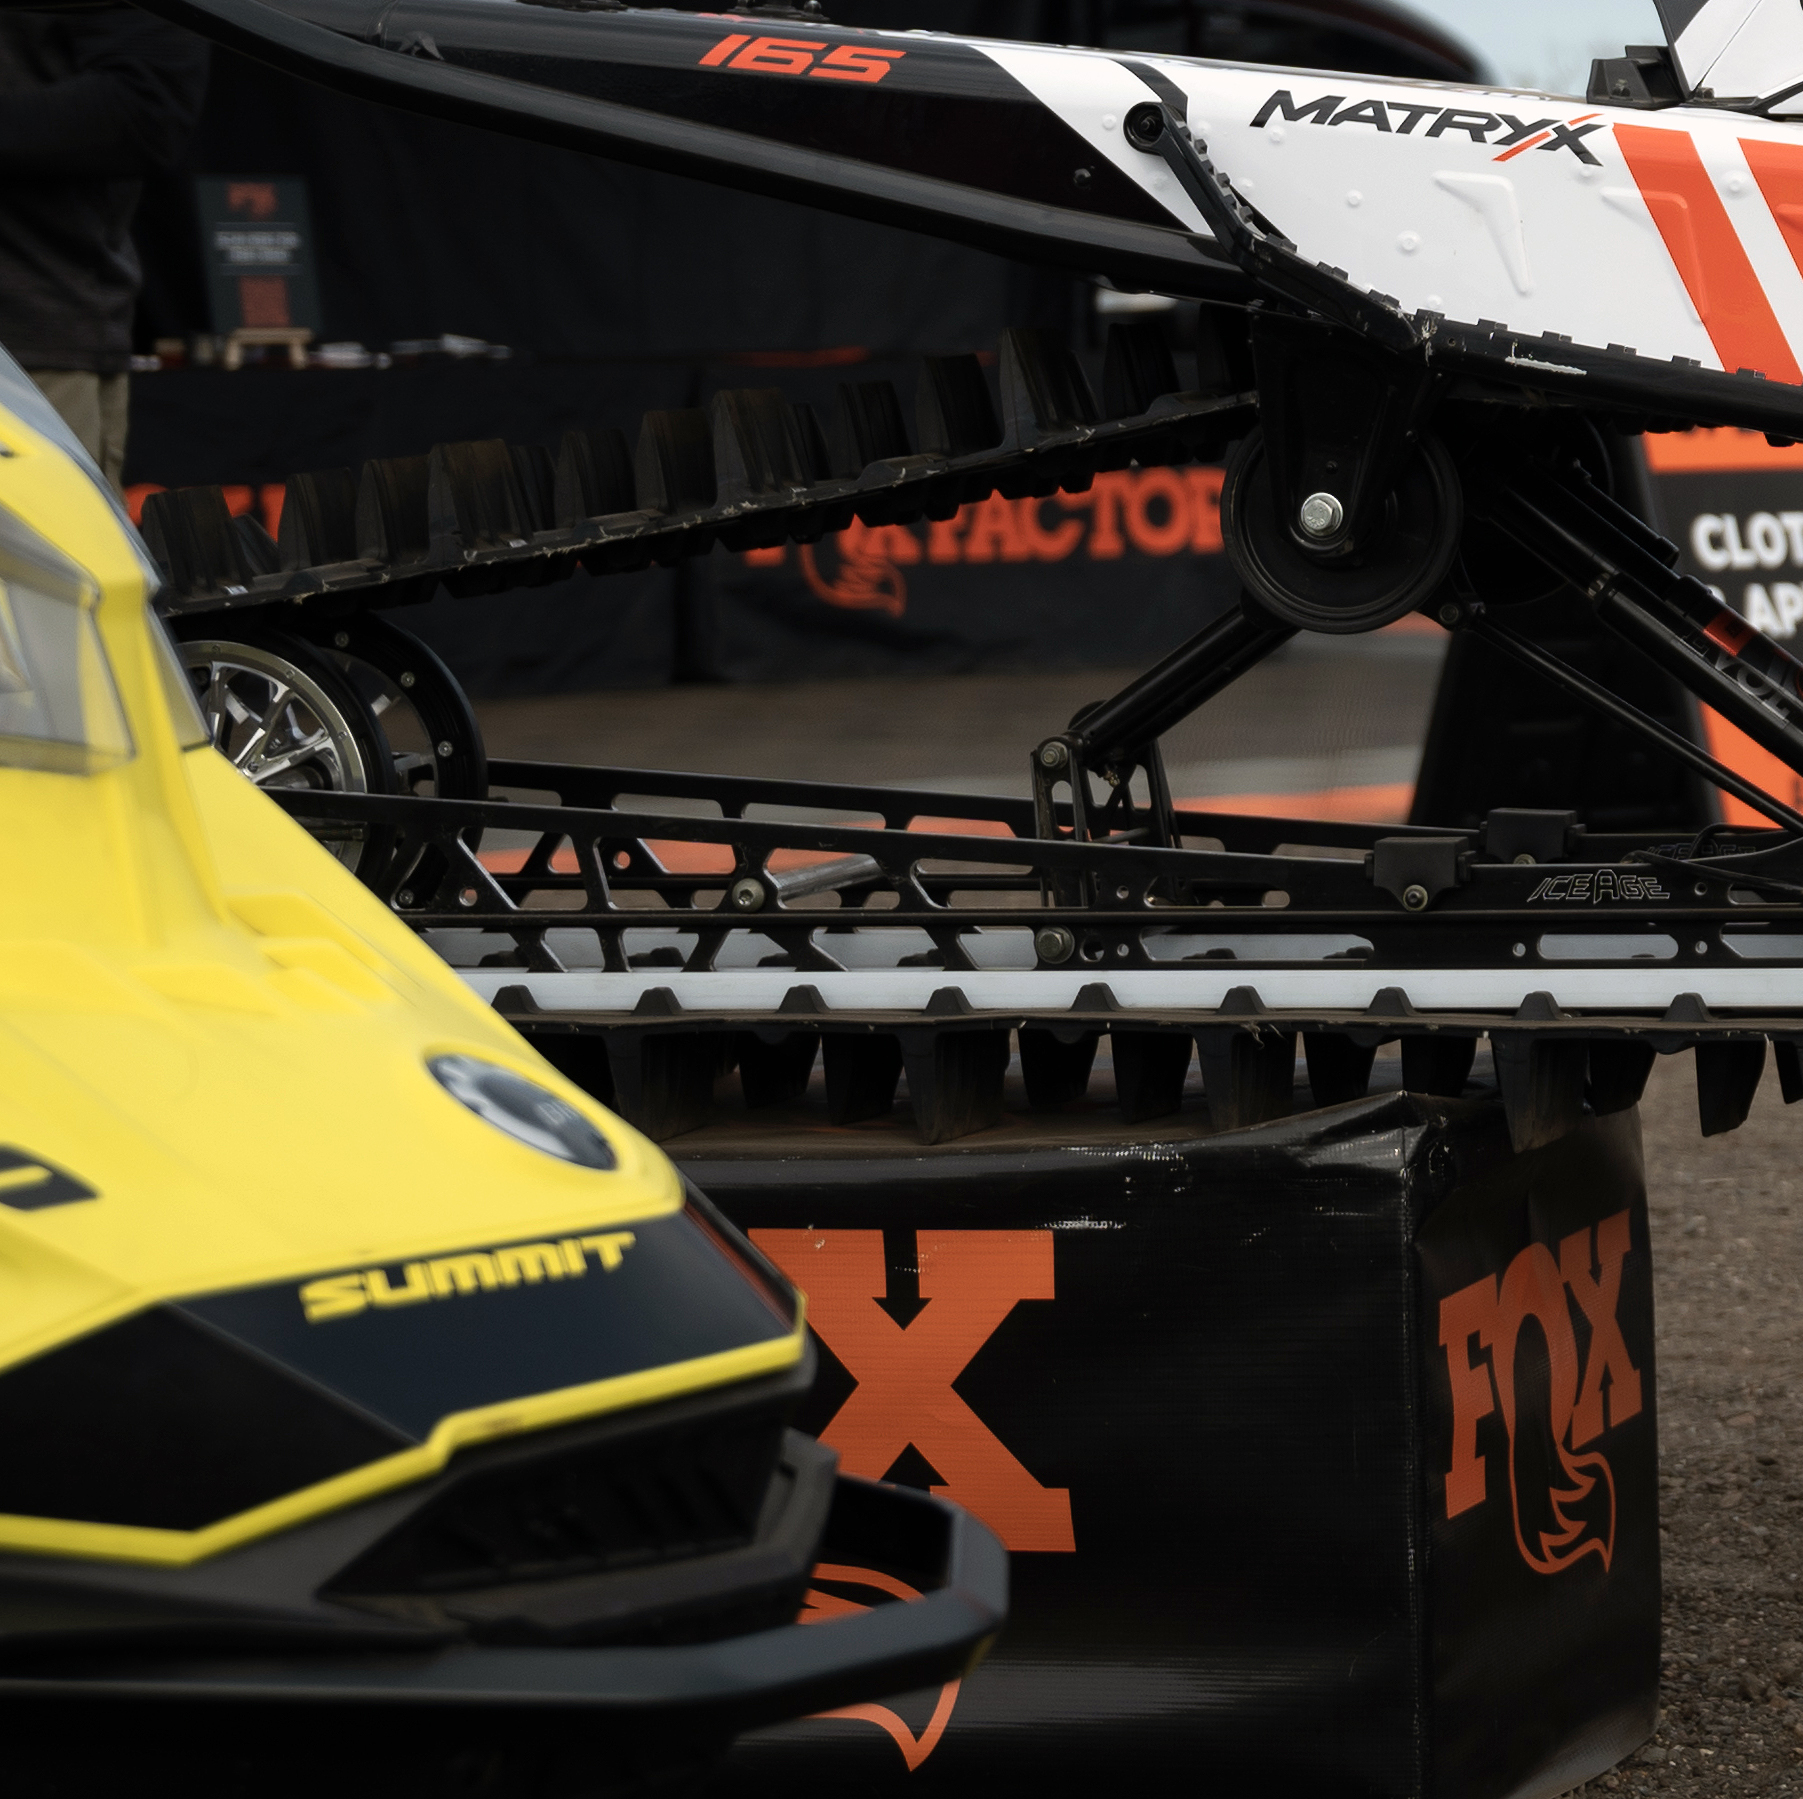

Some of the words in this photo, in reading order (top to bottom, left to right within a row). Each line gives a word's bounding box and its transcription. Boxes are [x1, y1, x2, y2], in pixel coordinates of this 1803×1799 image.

[699, 33, 906, 83] 165
[1249, 90, 1606, 167] MATRYX
[928, 467, 1226, 564] FACTOR
[1526, 869, 1671, 905] ICEAGE
[301, 1231, 636, 1324] SUMMIT
[1438, 1207, 1643, 1575] FOX
